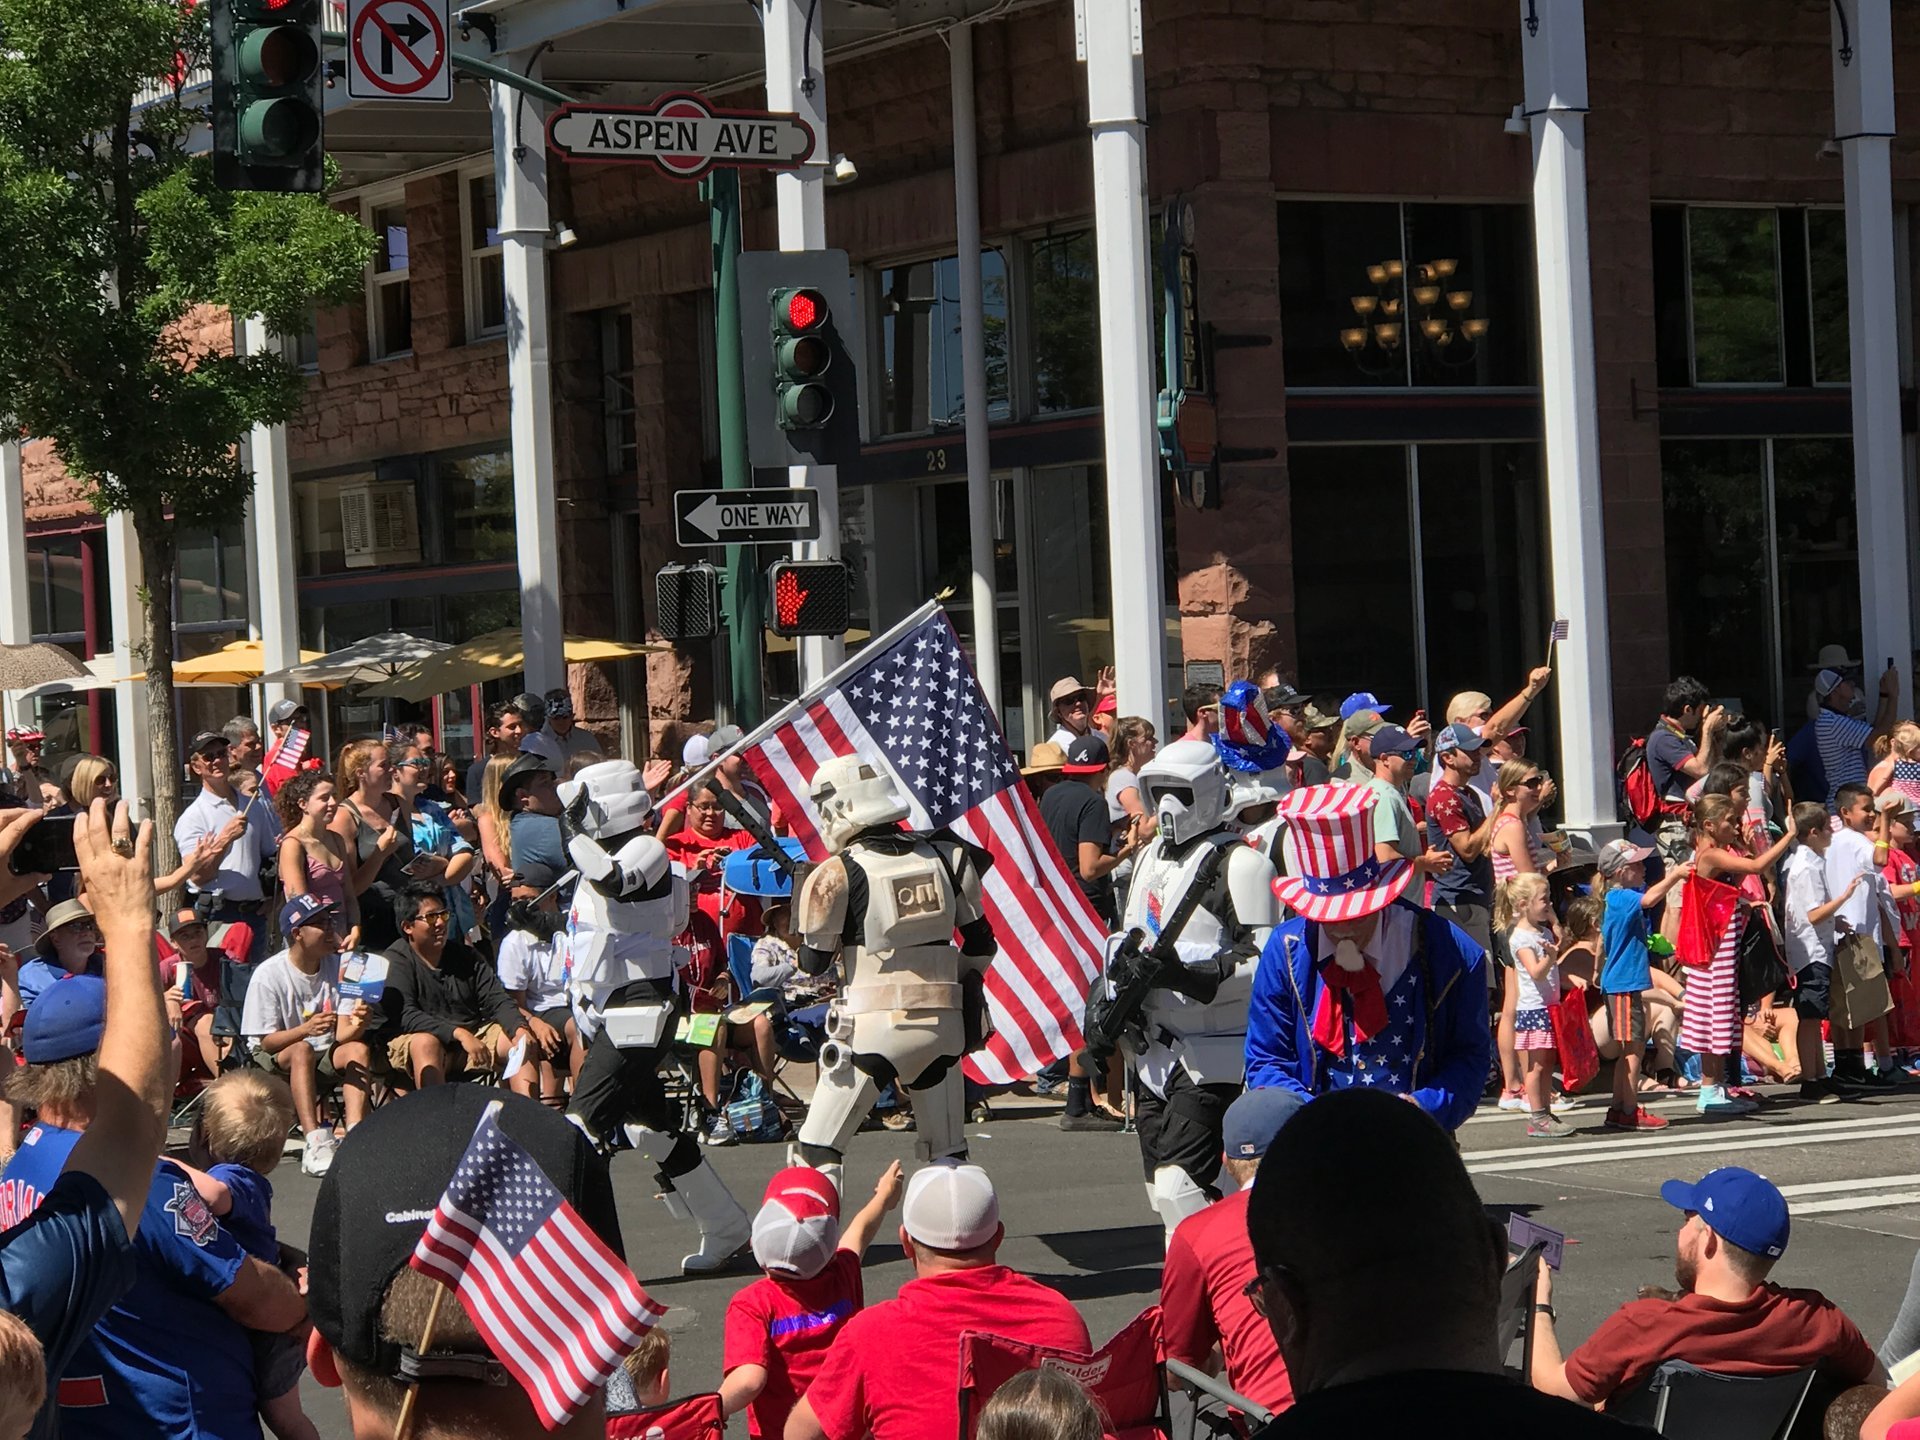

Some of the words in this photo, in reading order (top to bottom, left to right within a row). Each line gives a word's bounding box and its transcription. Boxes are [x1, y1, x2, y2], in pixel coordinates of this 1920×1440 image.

[588, 118, 698, 151] ASPEN
[714, 123, 777, 154] AVE
[926, 449, 946, 471] 23
[721, 506, 759, 526] ONE
[765, 505, 804, 525] WAY
[298, 894, 318, 911] 12
